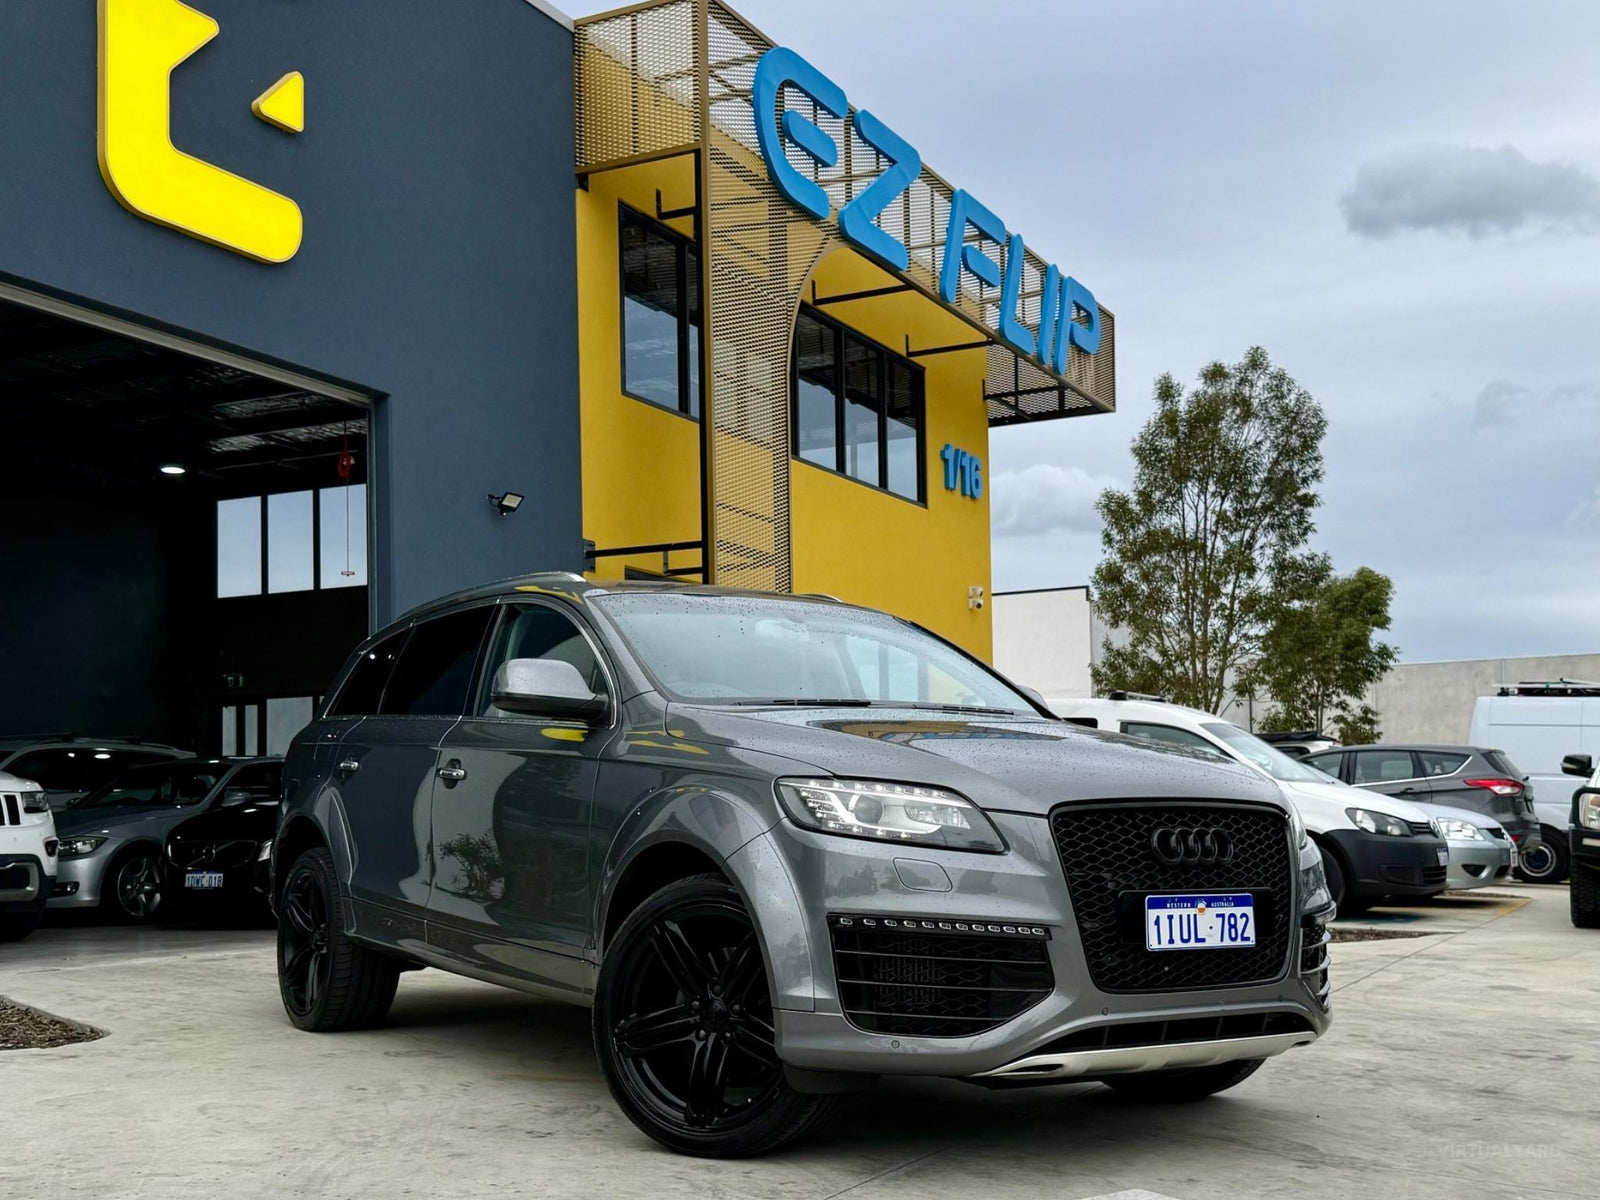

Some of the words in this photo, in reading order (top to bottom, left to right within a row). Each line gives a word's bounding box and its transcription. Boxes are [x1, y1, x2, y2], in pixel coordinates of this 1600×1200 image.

[752, 46, 921, 271] EZ
[940, 189, 1101, 376] FLIP
[940, 444, 983, 499] 1/16
[1215, 912, 1251, 942] 782
